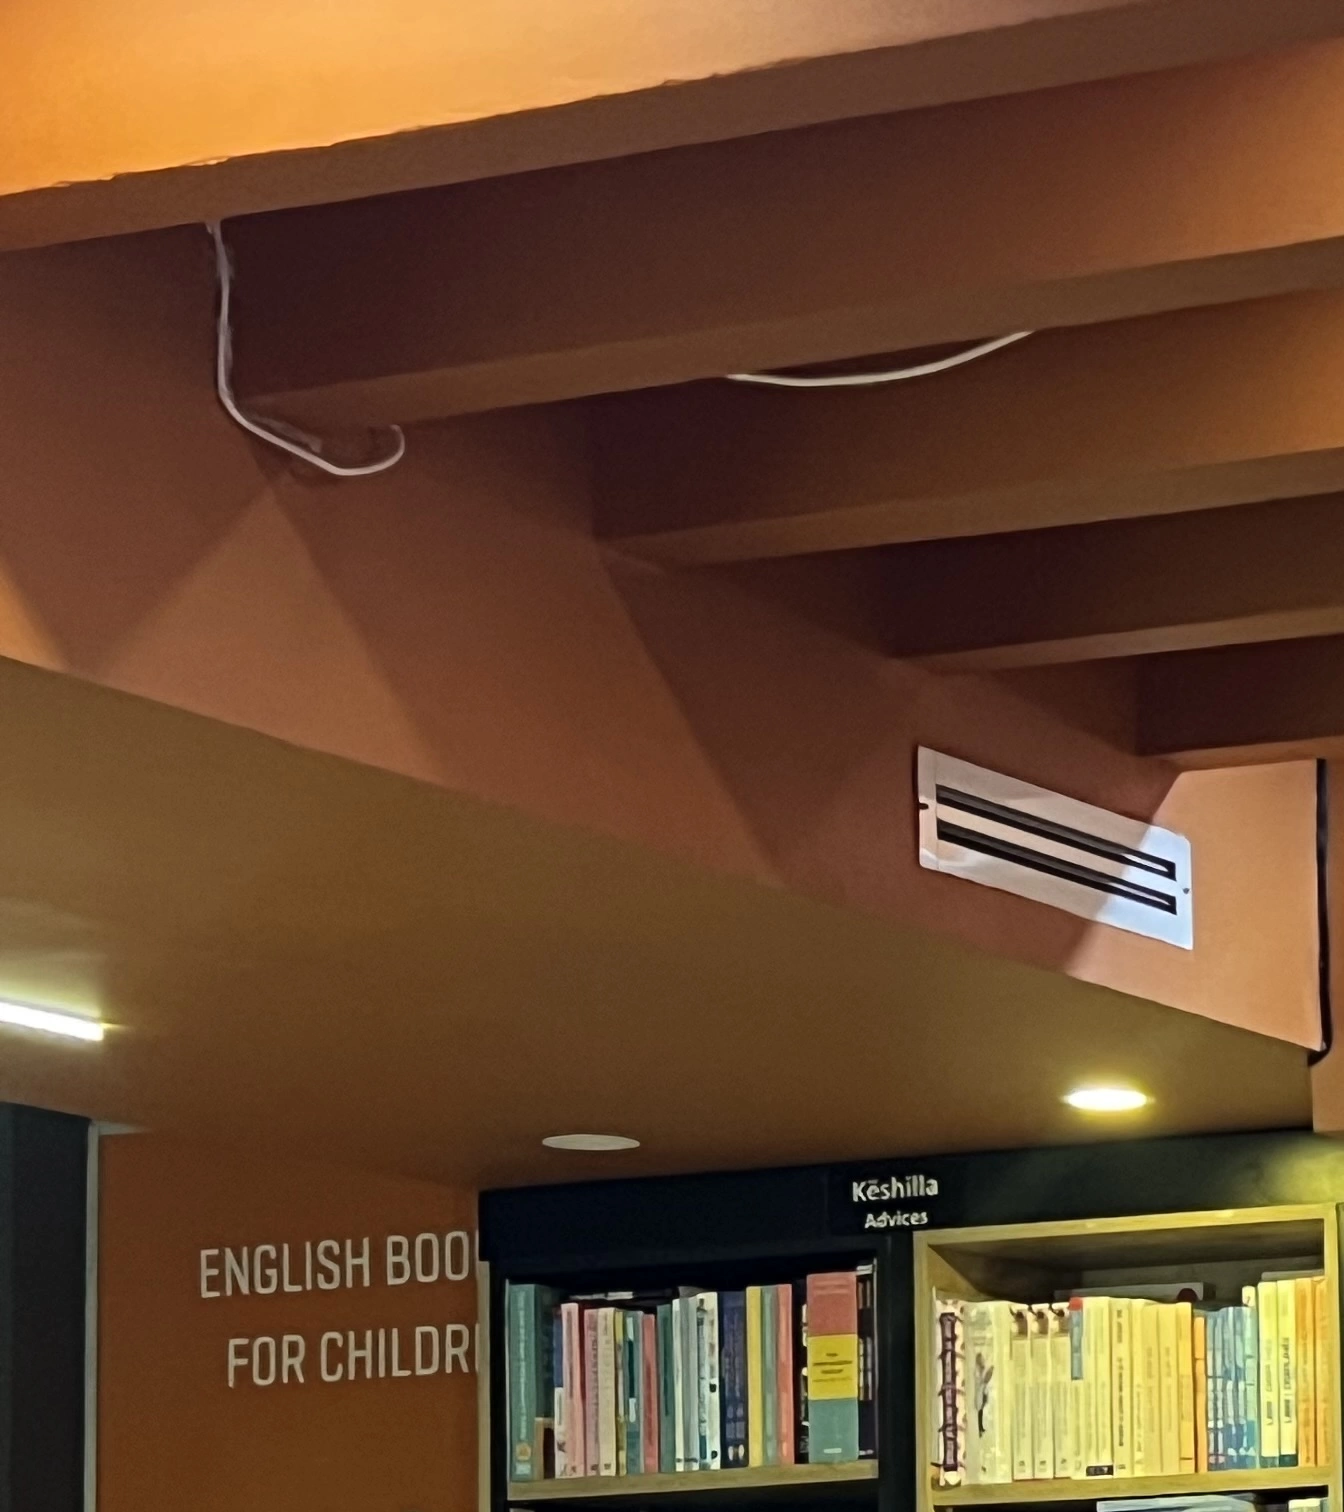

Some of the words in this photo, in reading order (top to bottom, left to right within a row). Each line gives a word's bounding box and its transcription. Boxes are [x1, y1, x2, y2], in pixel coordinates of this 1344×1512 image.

[864, 1210, 929, 1229] Advices
[200, 1237, 370, 1298] ENGLISH
[386, 1230, 478, 1286] BOO
[228, 1334, 304, 1388] FOR
[320, 1323, 478, 1383] CHILDR
